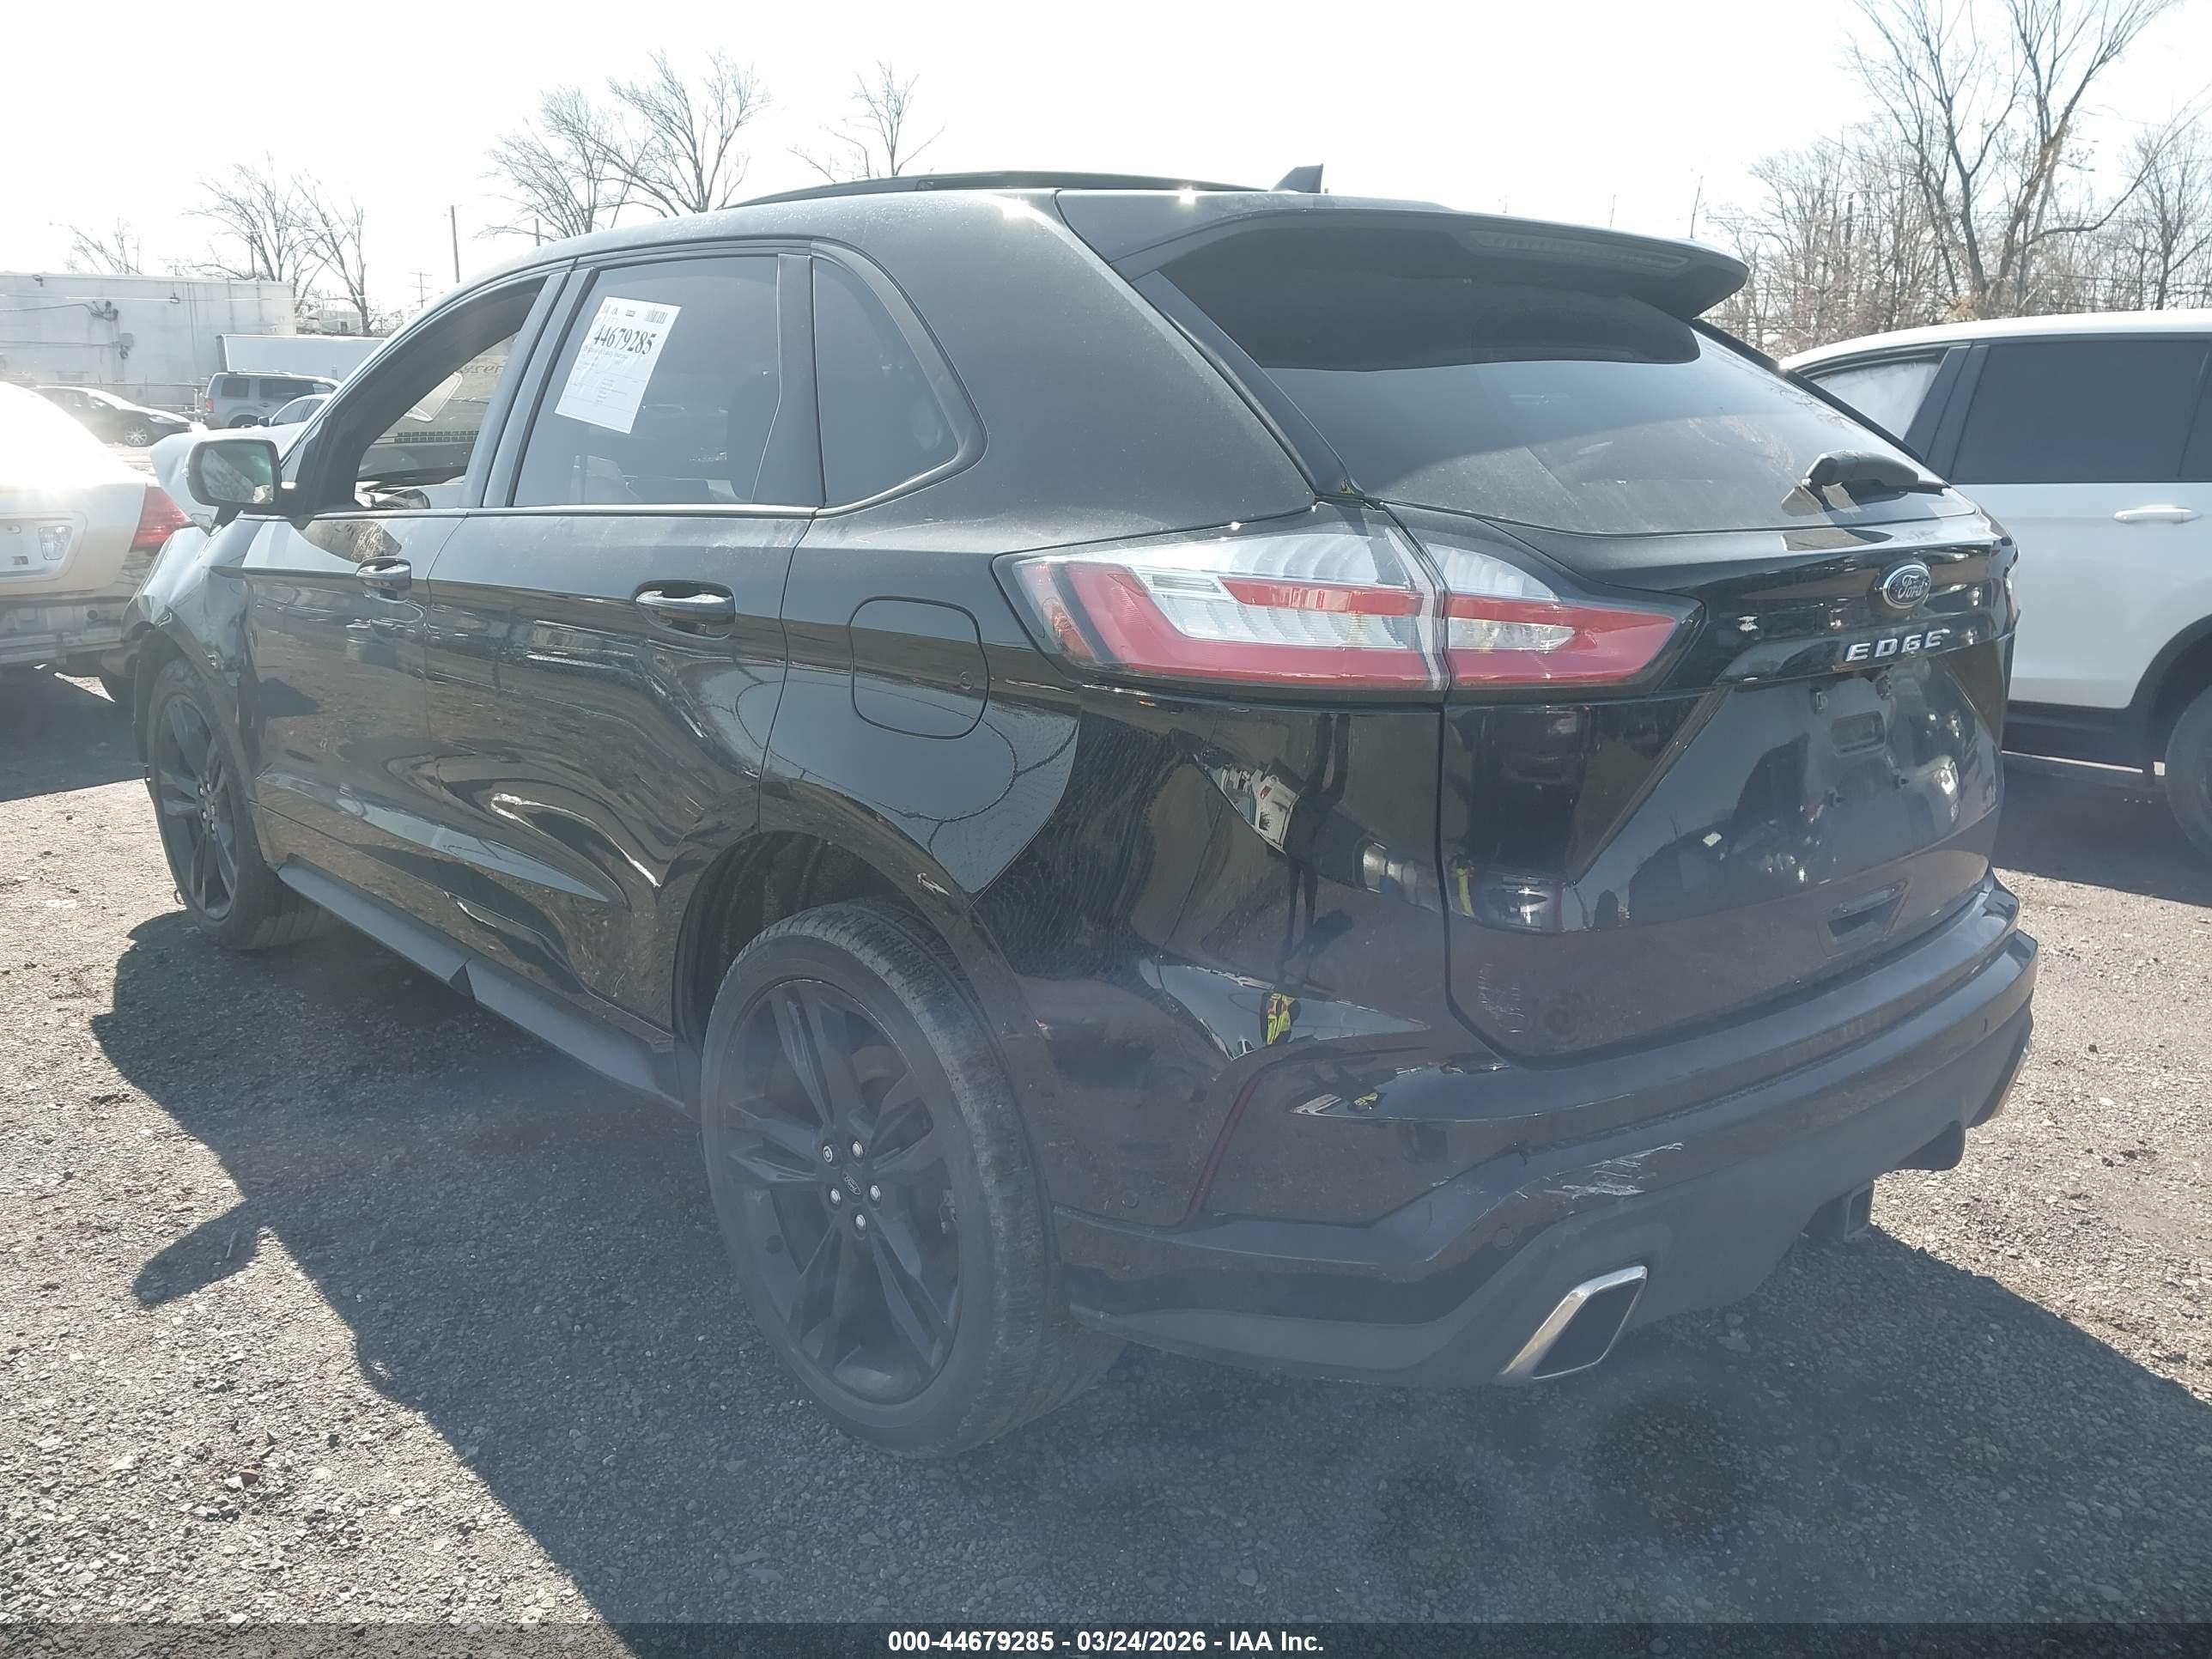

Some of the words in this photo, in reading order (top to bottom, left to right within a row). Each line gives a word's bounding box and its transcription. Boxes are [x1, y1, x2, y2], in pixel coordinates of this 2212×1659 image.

[593, 324, 657, 355] 44679285
[1897, 574, 1928, 599] Ford
[1844, 629, 1951, 662] EDGE
